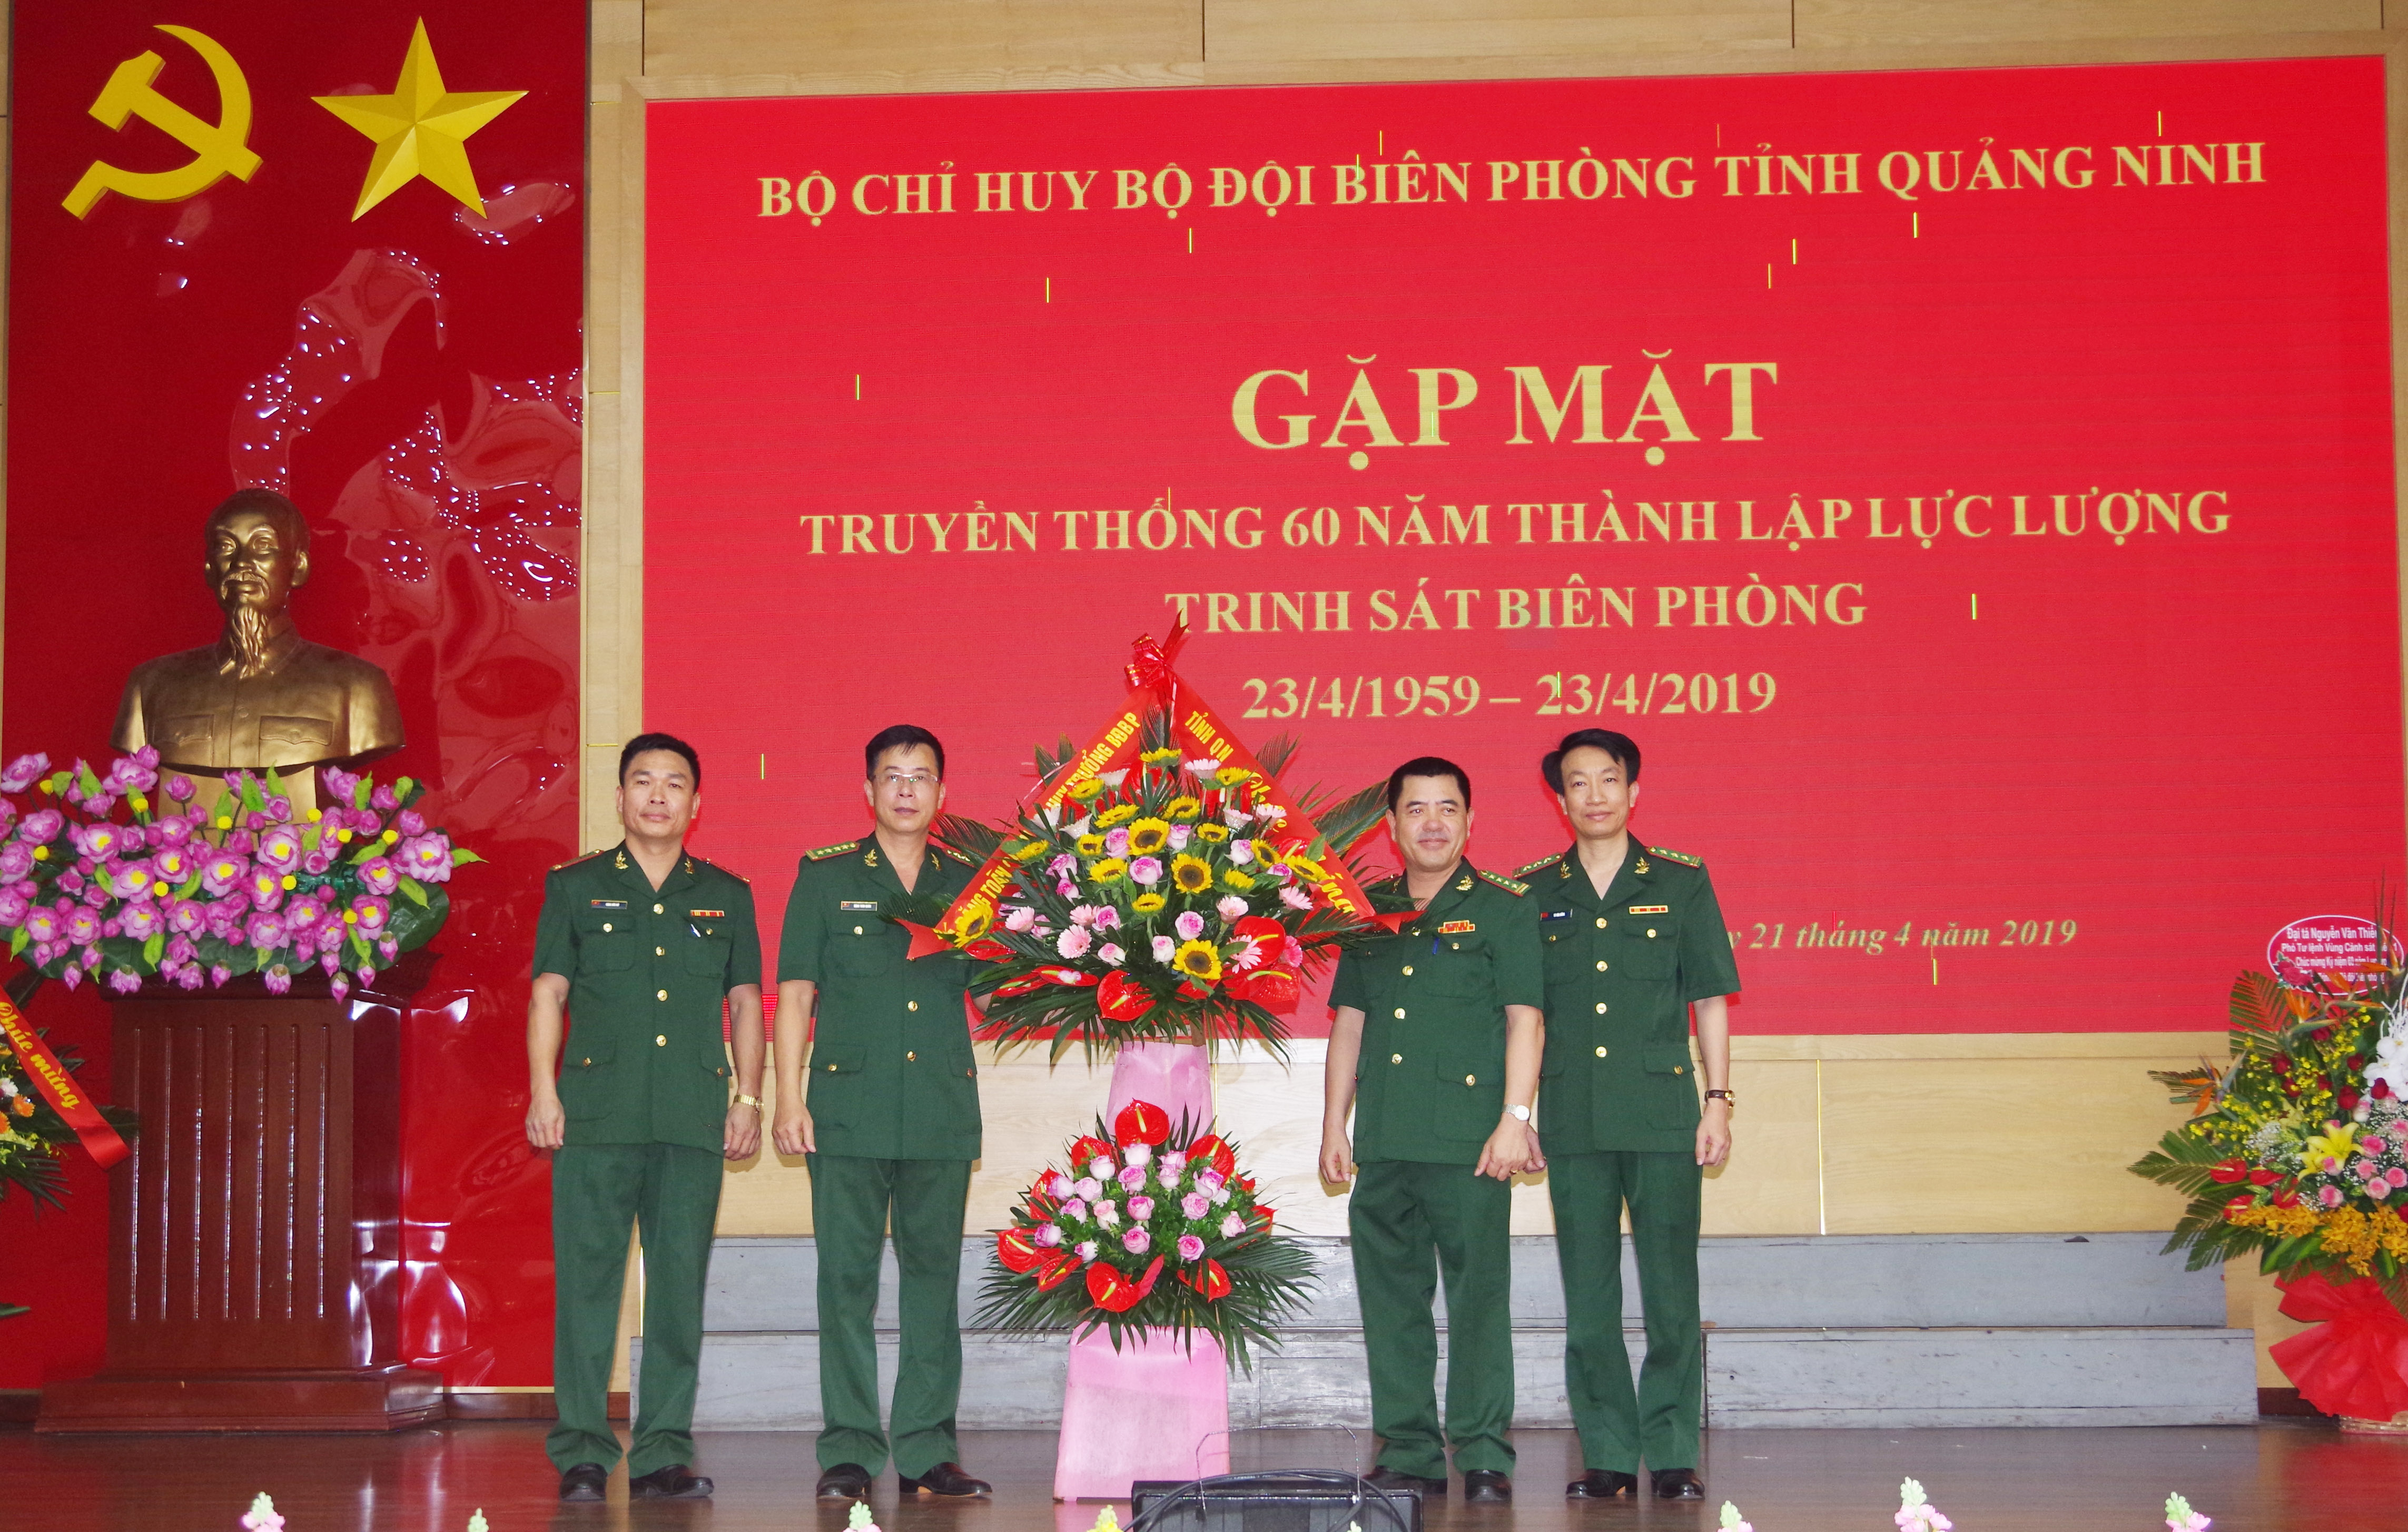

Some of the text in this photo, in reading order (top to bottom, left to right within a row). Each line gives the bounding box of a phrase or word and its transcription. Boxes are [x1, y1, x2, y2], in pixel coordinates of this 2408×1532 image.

[758, 137, 2265, 227] BỘ CHỈ HUY BỘ ĐỘI BIÊN PHÒNG TỈNH QUẢNG NINH
[1231, 348, 1778, 470] GẶP MẶT
[800, 485, 2231, 555] TRUYỀN THỐNG 60 NĂM THÀNH LẬP LỰC LƯỢNG
[1164, 573, 1867, 634] TRINH SÁT BIÊN PHÒNG
[1241, 675, 1482, 719] 23/4/1959
[1535, 671, 1777, 715] 23/4/2019
[1105, 712, 1141, 749] BĐBP
[1185, 711, 1216, 744] TỈNH
[1748, 922, 1784, 948] 21
[1795, 919, 1887, 955] tháng
[1893, 921, 1912, 947] 4
[1921, 922, 1990, 947] năm
[2000, 919, 2077, 946] 2019
[30, 1053, 80, 1110] mừng
